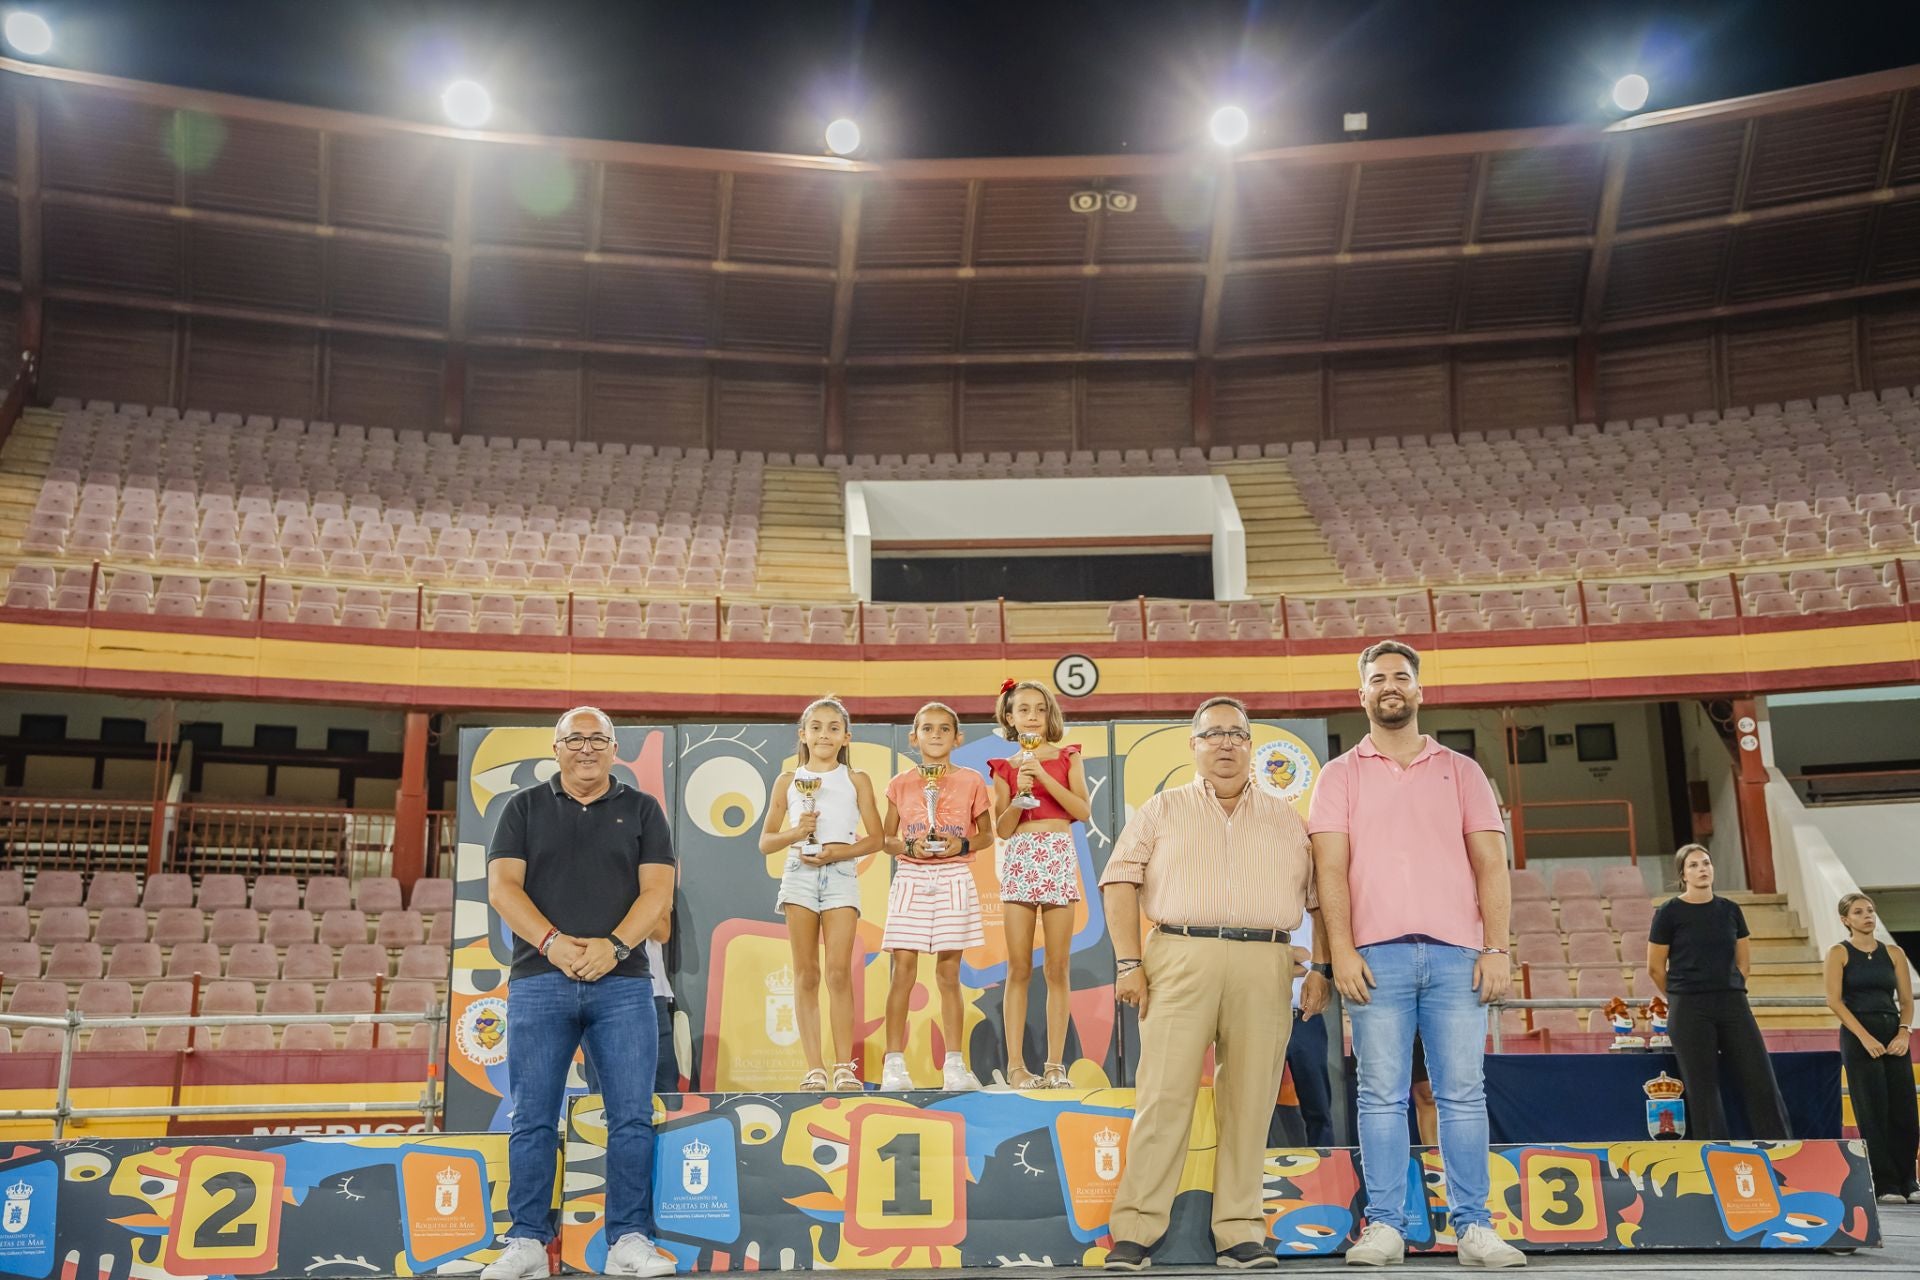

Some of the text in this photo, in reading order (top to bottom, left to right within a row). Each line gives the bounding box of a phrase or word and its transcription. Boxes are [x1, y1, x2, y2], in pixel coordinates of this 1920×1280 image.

[1068, 663, 1085, 690] 5
[485, 1055, 506, 1065] VIDA
[877, 1133, 932, 1216] 1
[1538, 1167, 1584, 1226] 3
[193, 1171, 257, 1248] 2
